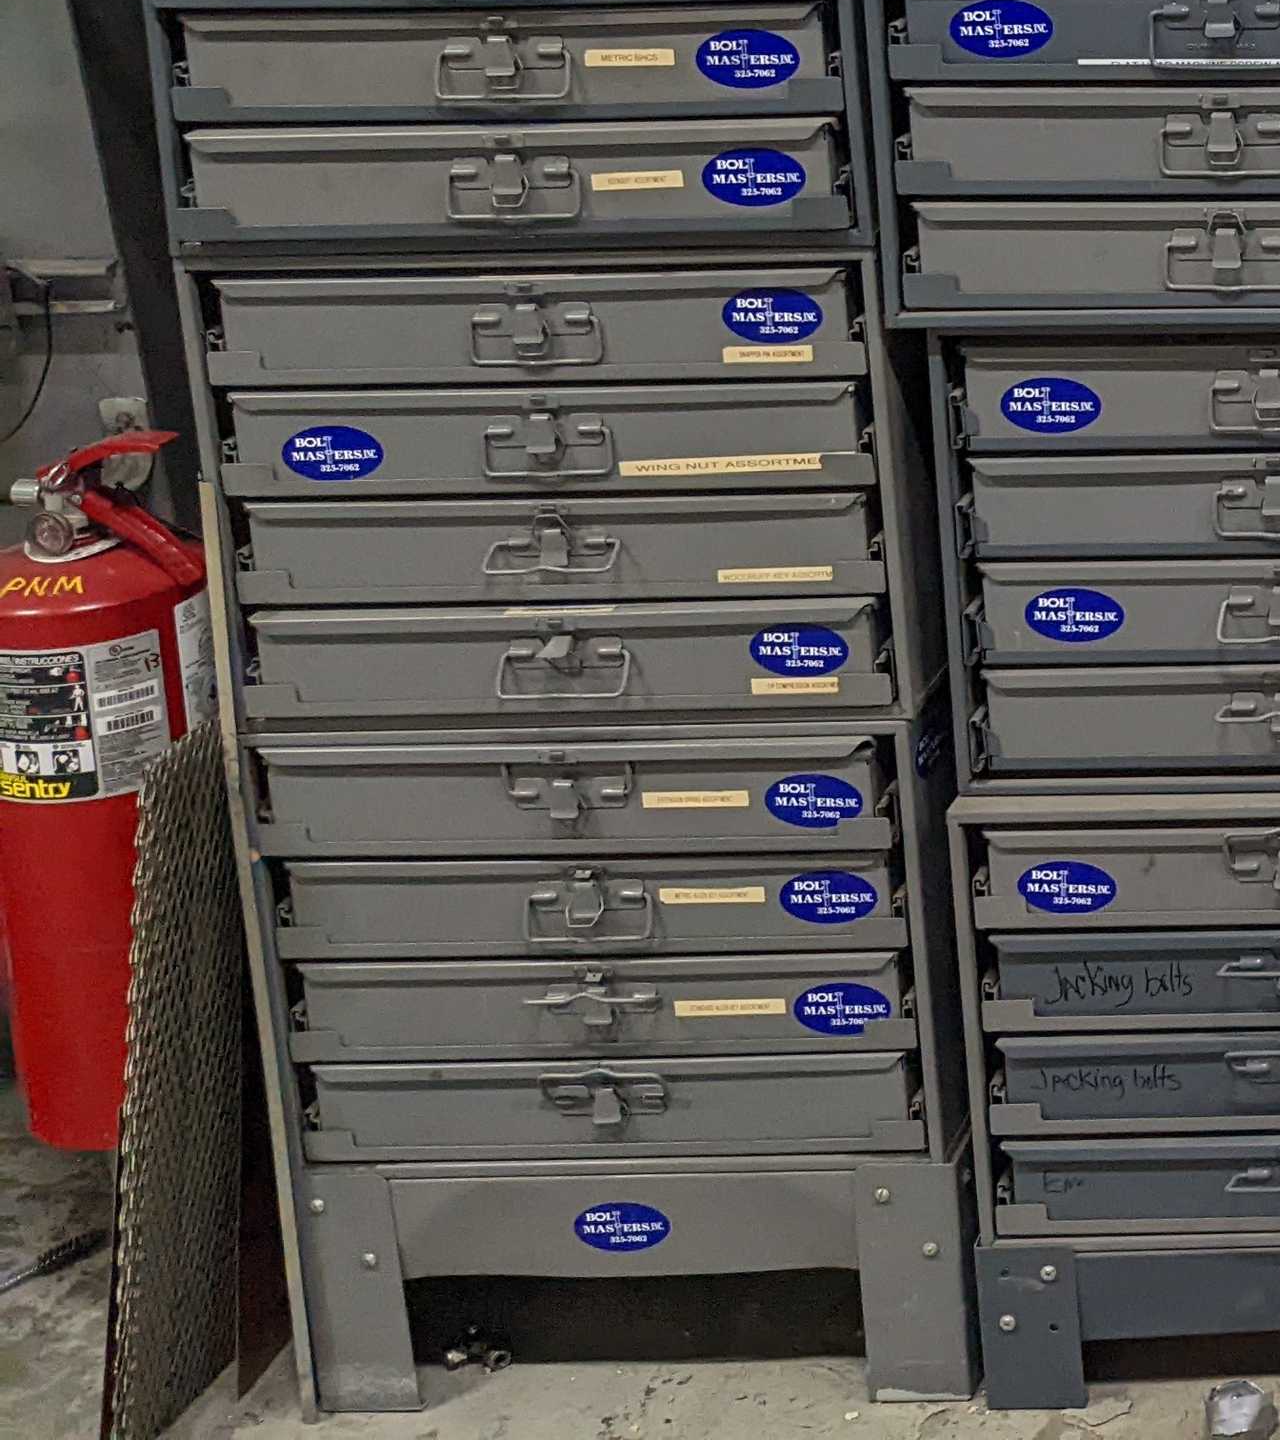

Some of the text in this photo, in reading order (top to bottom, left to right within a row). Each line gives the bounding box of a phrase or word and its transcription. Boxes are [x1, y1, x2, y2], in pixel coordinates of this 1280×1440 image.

[635, 463, 680, 473] WING
[686, 461, 720, 470] NUT
[0, 576, 84, 598] PNM
[0, 779, 71, 799] sentry
